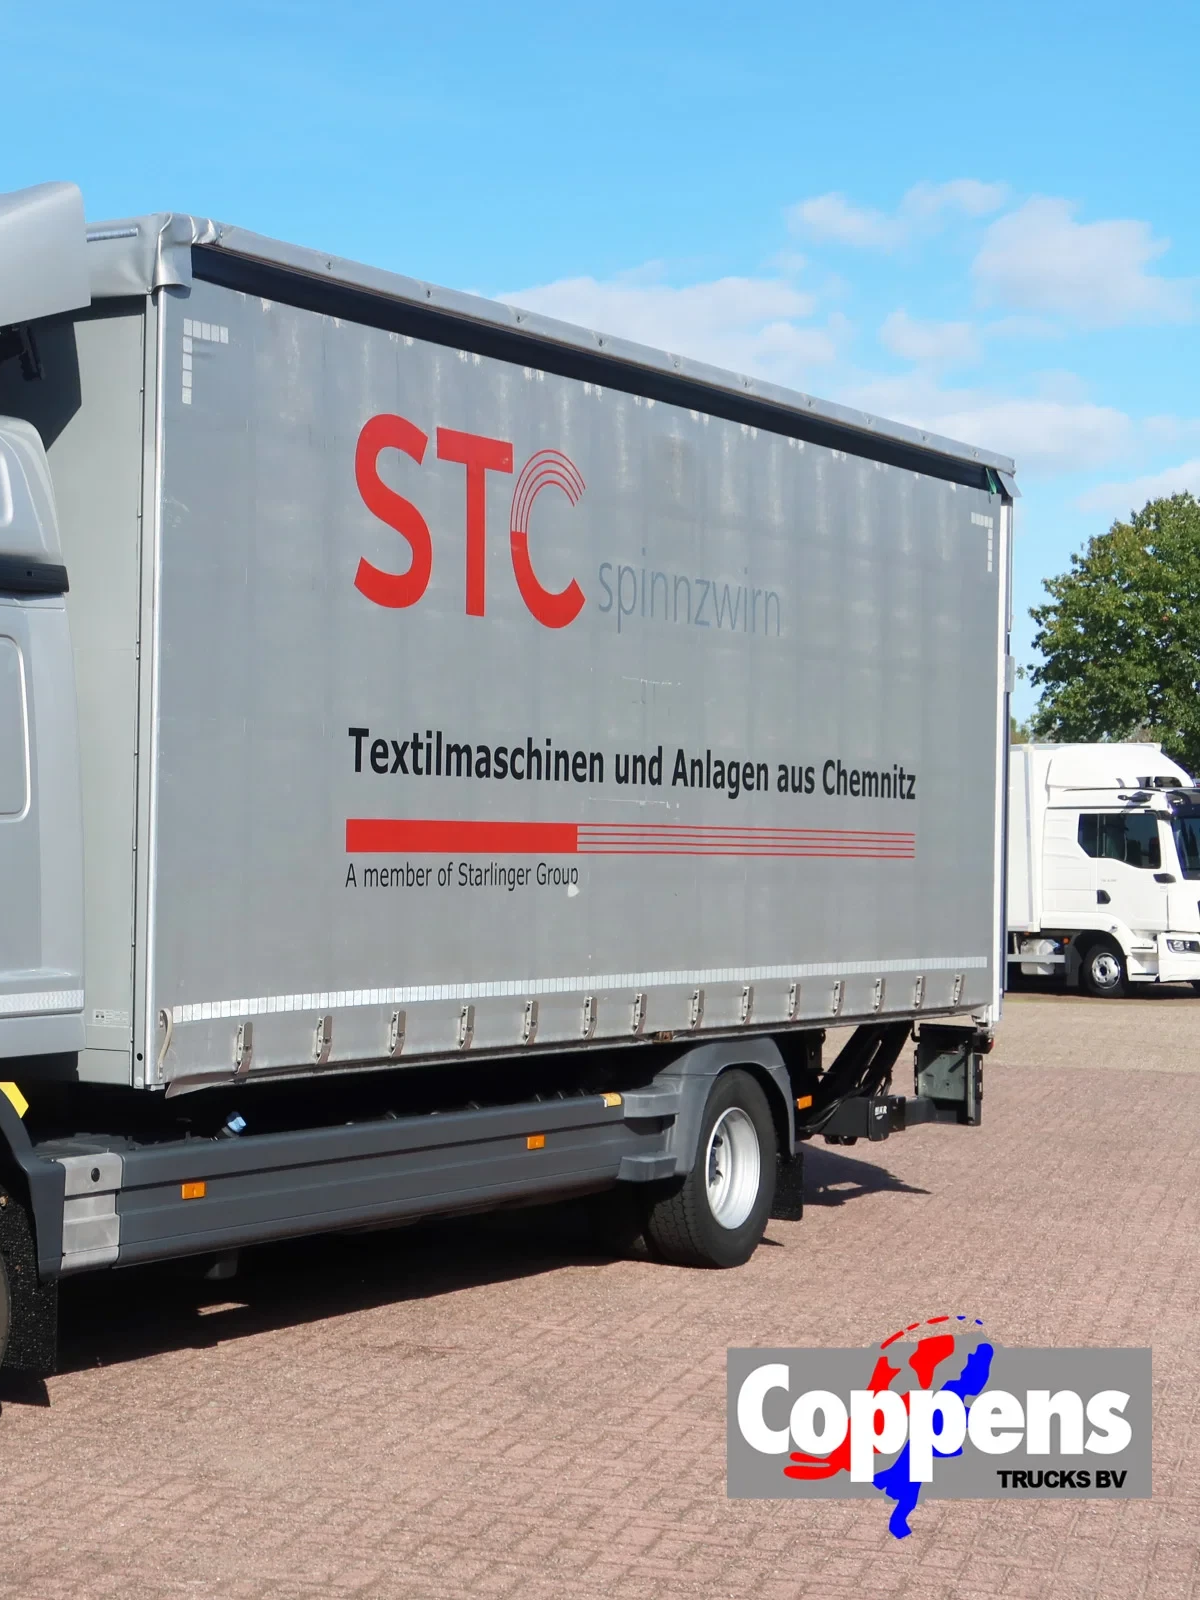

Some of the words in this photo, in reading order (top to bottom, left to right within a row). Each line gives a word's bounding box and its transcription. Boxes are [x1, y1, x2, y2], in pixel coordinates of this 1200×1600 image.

[354, 413, 587, 629] STC
[598, 546, 781, 637] spinnzwirn
[348, 727, 604, 783] Textilmaschinen
[614, 745, 663, 786] und
[671, 748, 769, 800] Anlagen
[776, 763, 816, 795] aus
[822, 758, 917, 801] Chemnitz
[345, 862, 357, 888] A
[363, 861, 432, 887] member
[437, 861, 454, 887] of
[458, 861, 532, 892] Starlinger
[536, 862, 580, 888] Group
